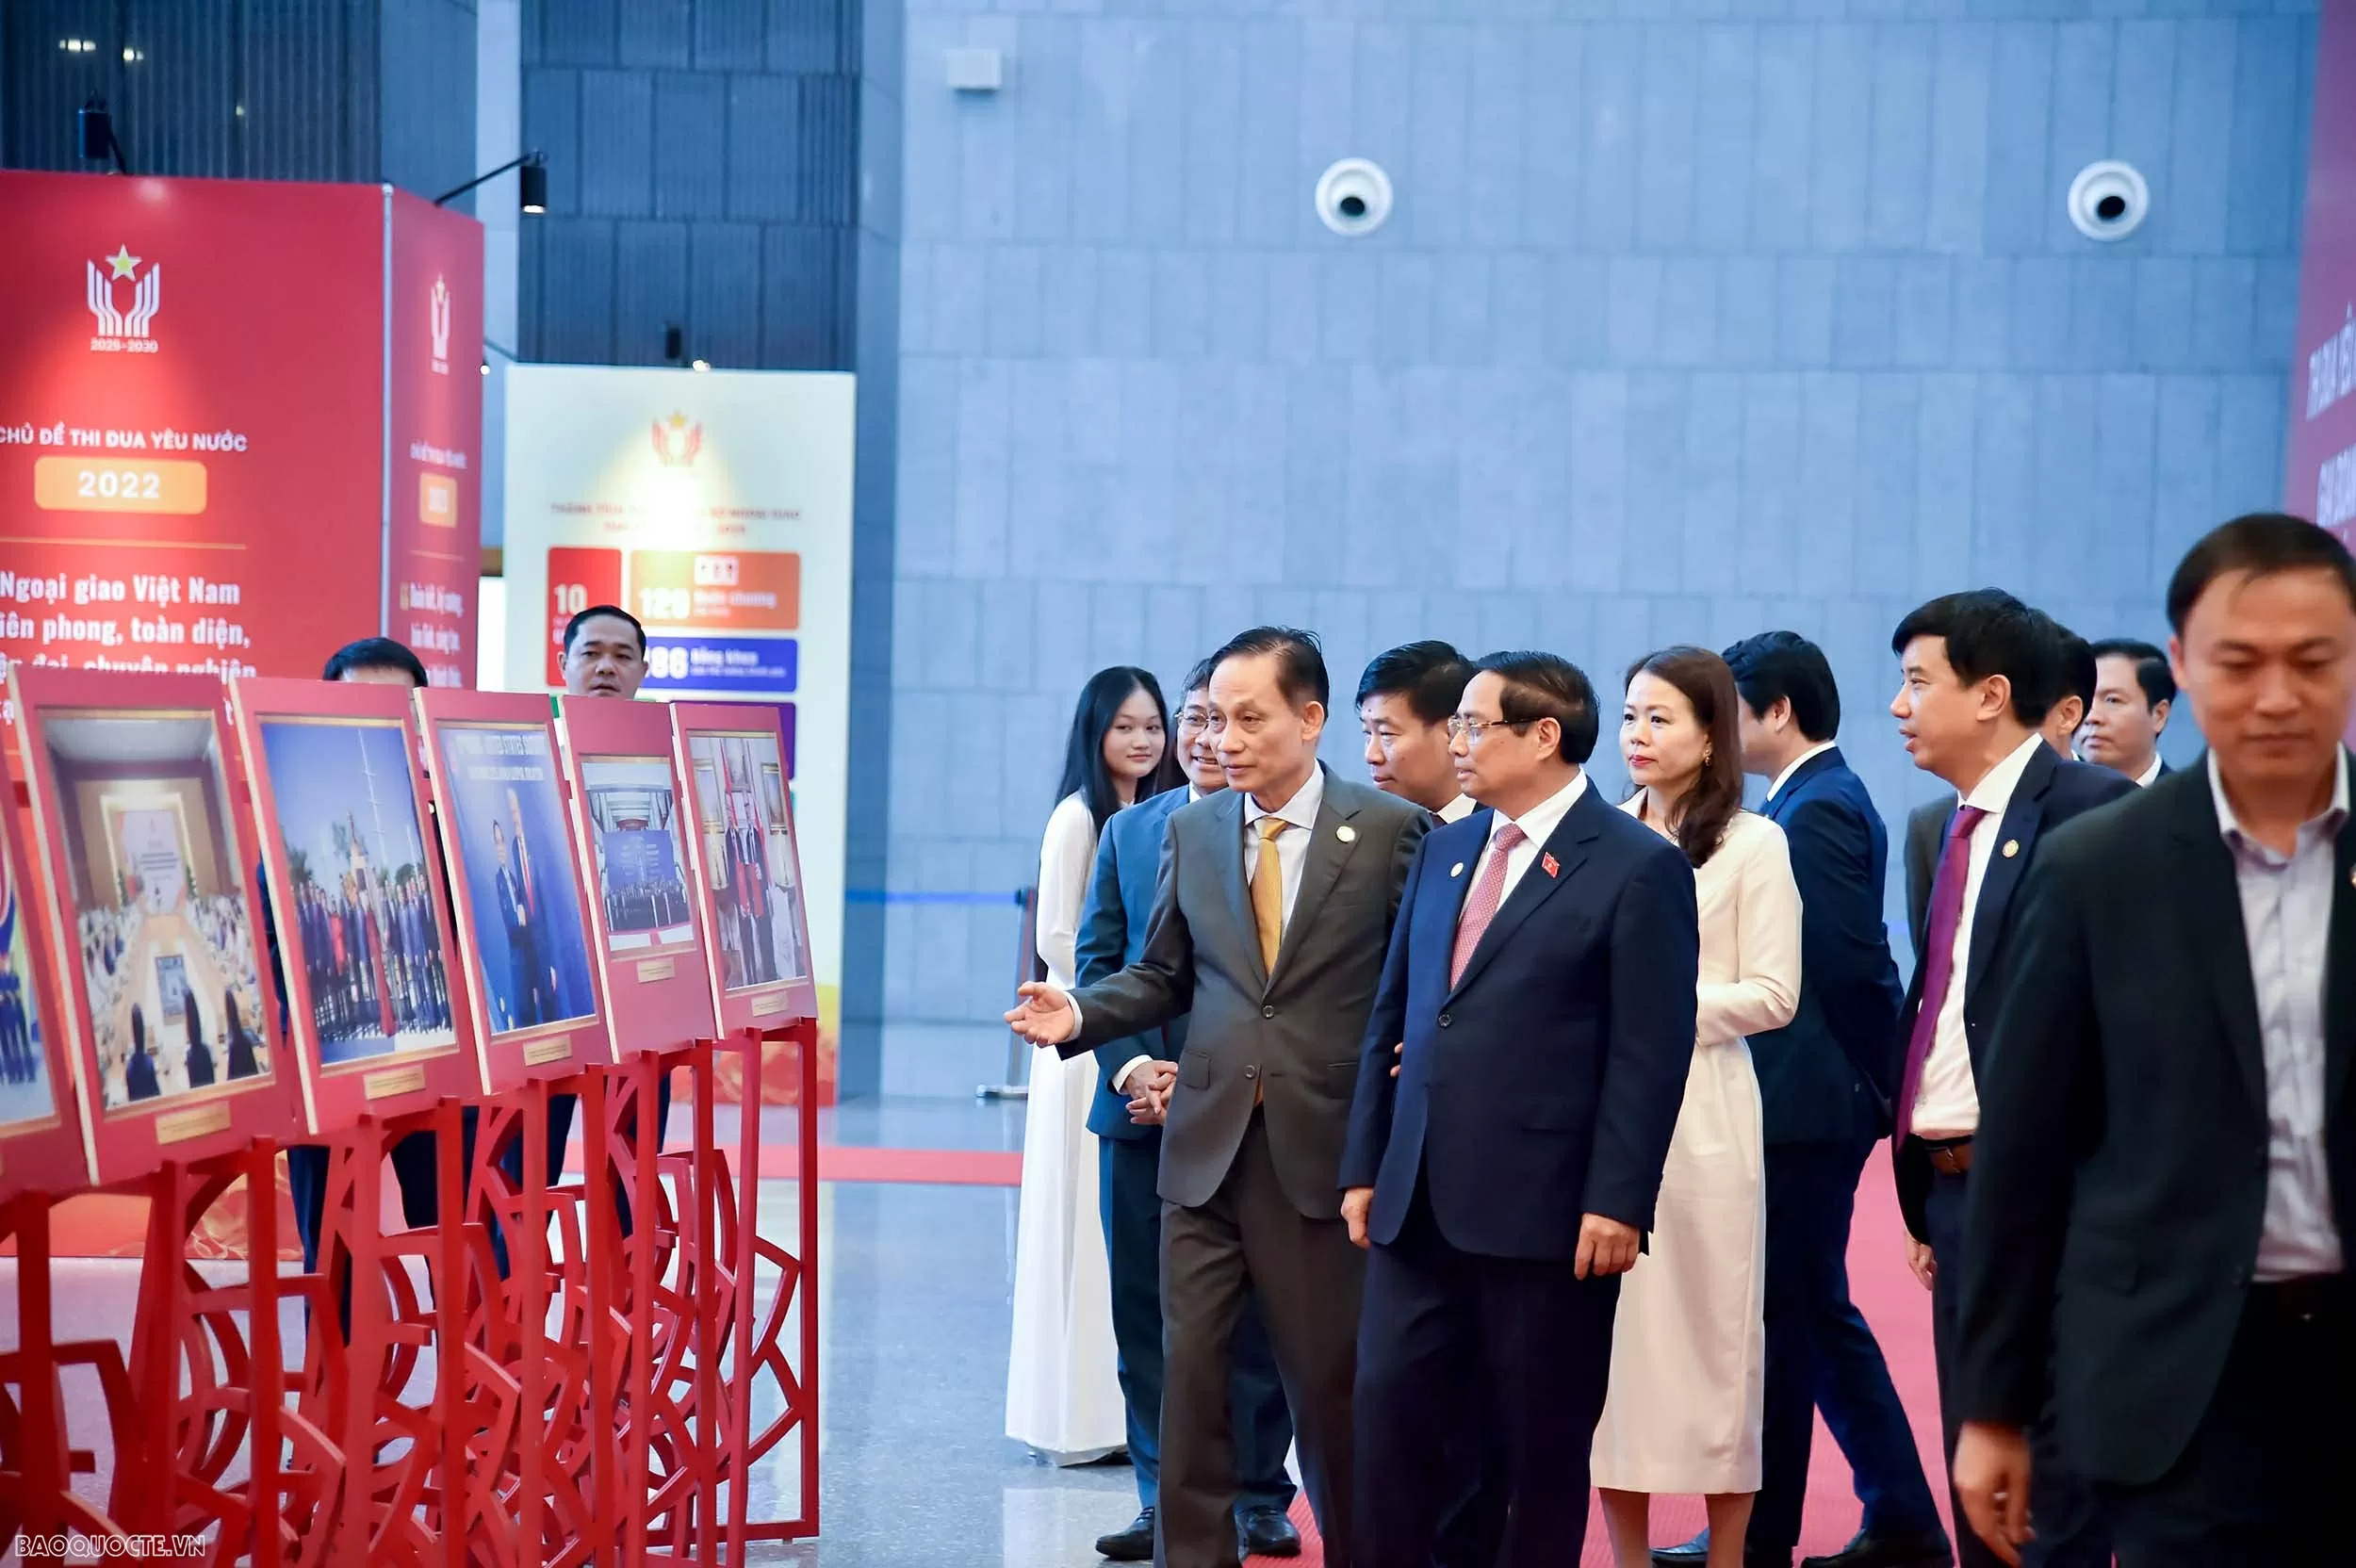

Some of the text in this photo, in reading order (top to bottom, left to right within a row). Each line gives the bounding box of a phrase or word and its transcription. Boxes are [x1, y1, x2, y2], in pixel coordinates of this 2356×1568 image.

[70, 428, 101, 447] THI
[105, 430, 147, 449] ĐUA
[151, 427, 188, 449] YÊU
[192, 429, 248, 451] NƯỚC
[77, 470, 161, 498] 2022
[0, 570, 240, 608] Ngoại giao Việt Nam
[553, 583, 588, 615] 10
[42, 612, 123, 645] phong,
[131, 614, 184, 644] toàn
[191, 617, 251, 650] diện,
